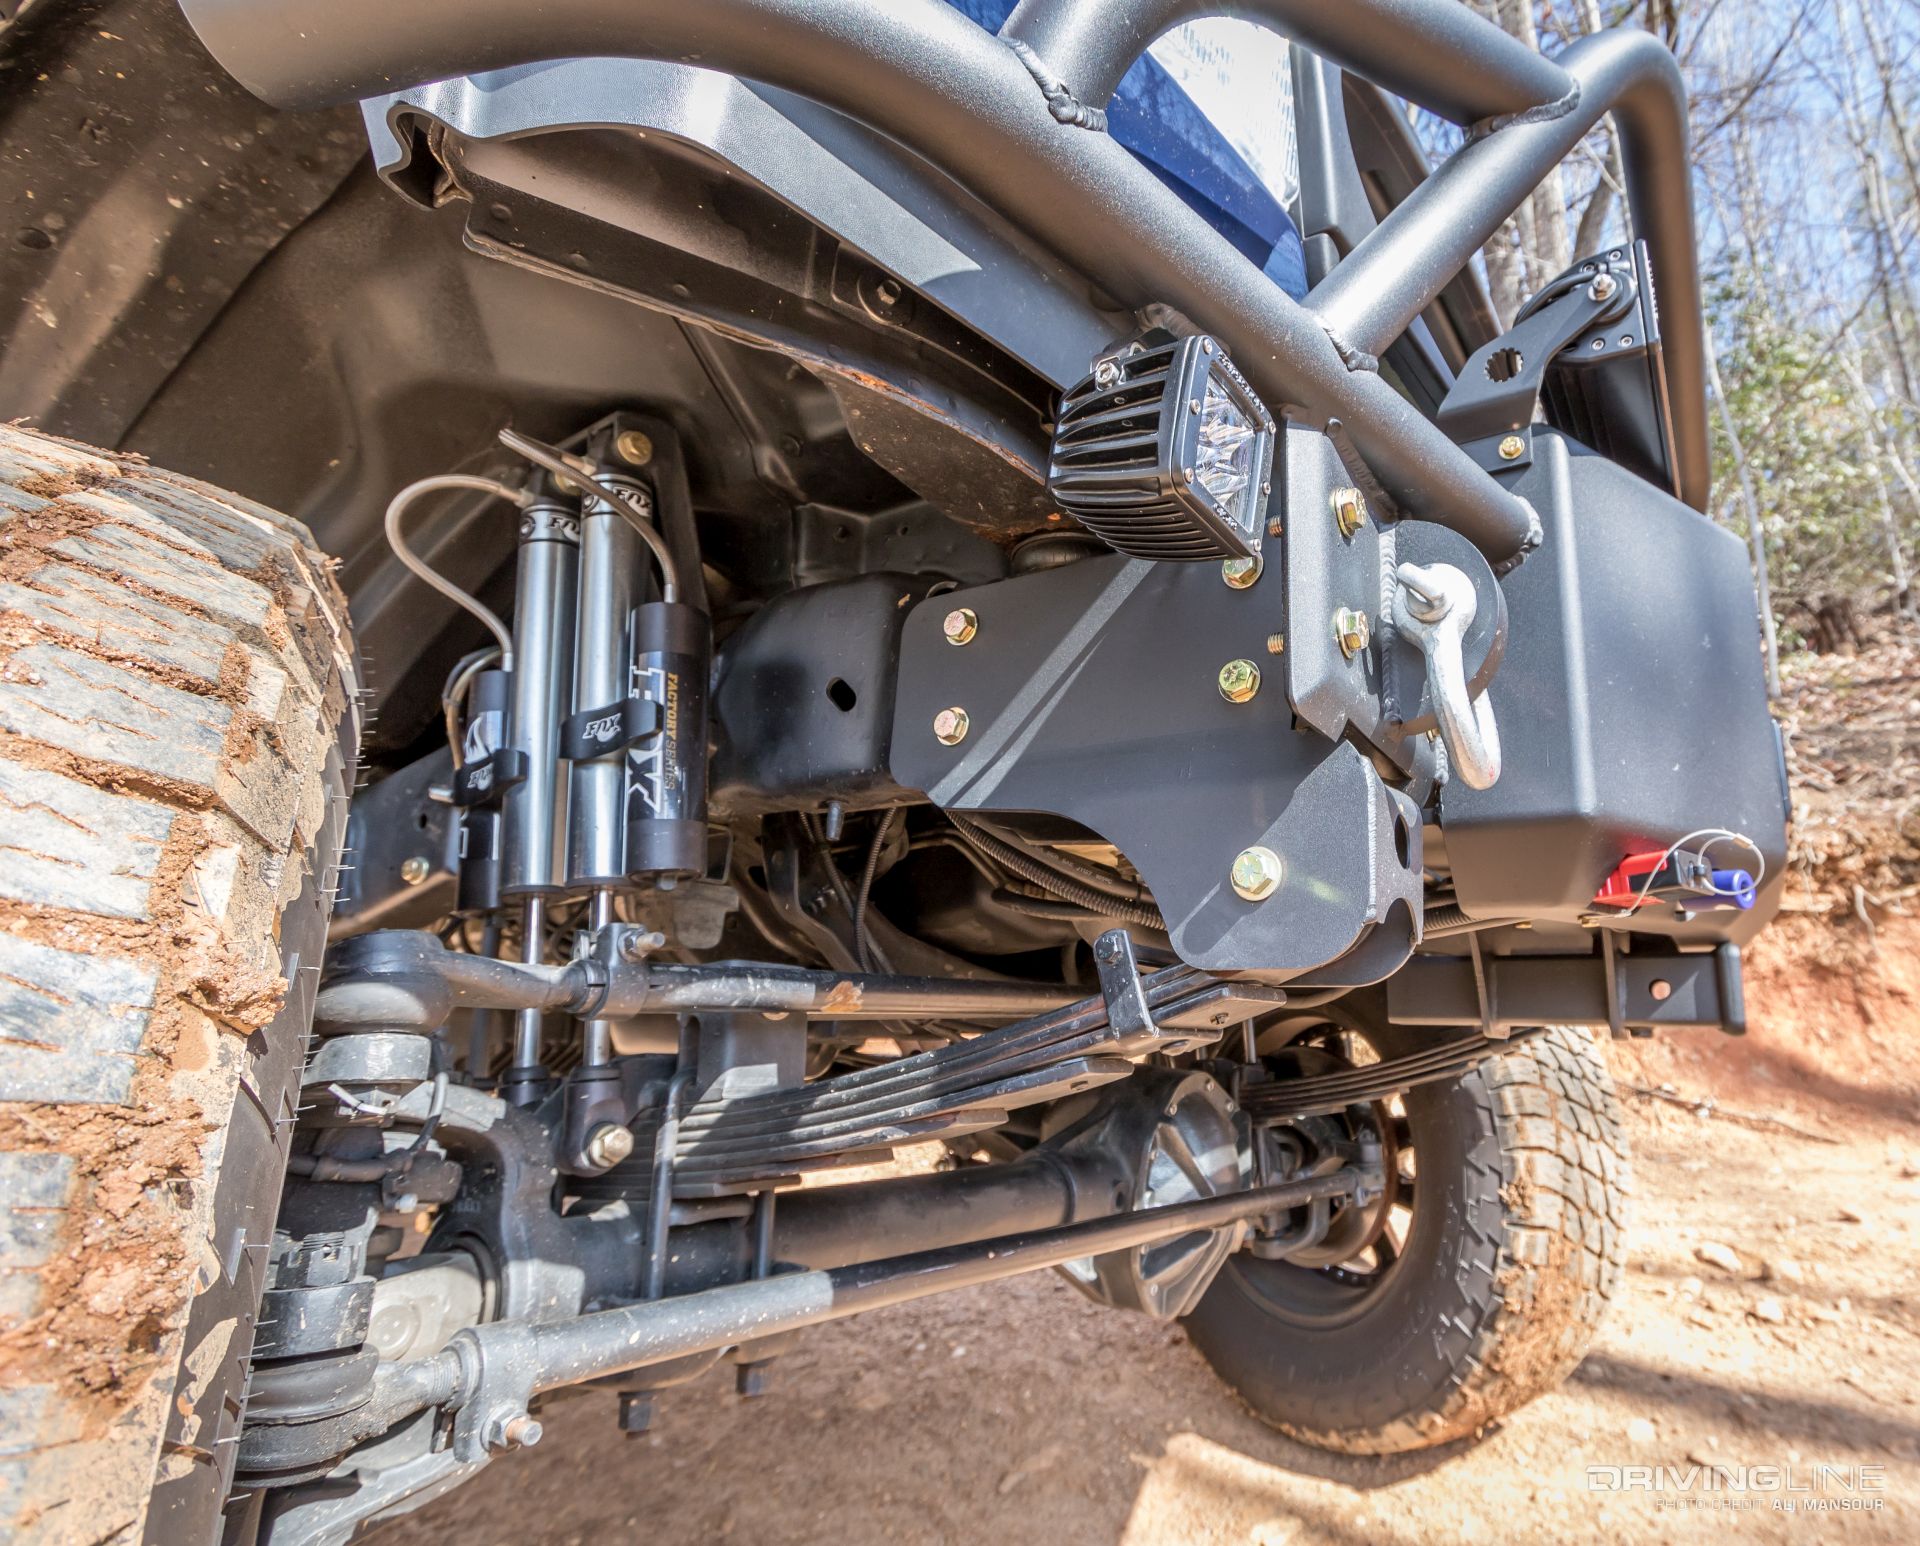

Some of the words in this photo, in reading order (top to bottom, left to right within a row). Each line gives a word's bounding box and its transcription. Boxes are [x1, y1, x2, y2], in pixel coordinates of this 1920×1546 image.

[547, 514, 580, 543] FO
[582, 712, 623, 743] FOX
[665, 672, 680, 742] FACTORY
[664, 740, 678, 791] SERIES
